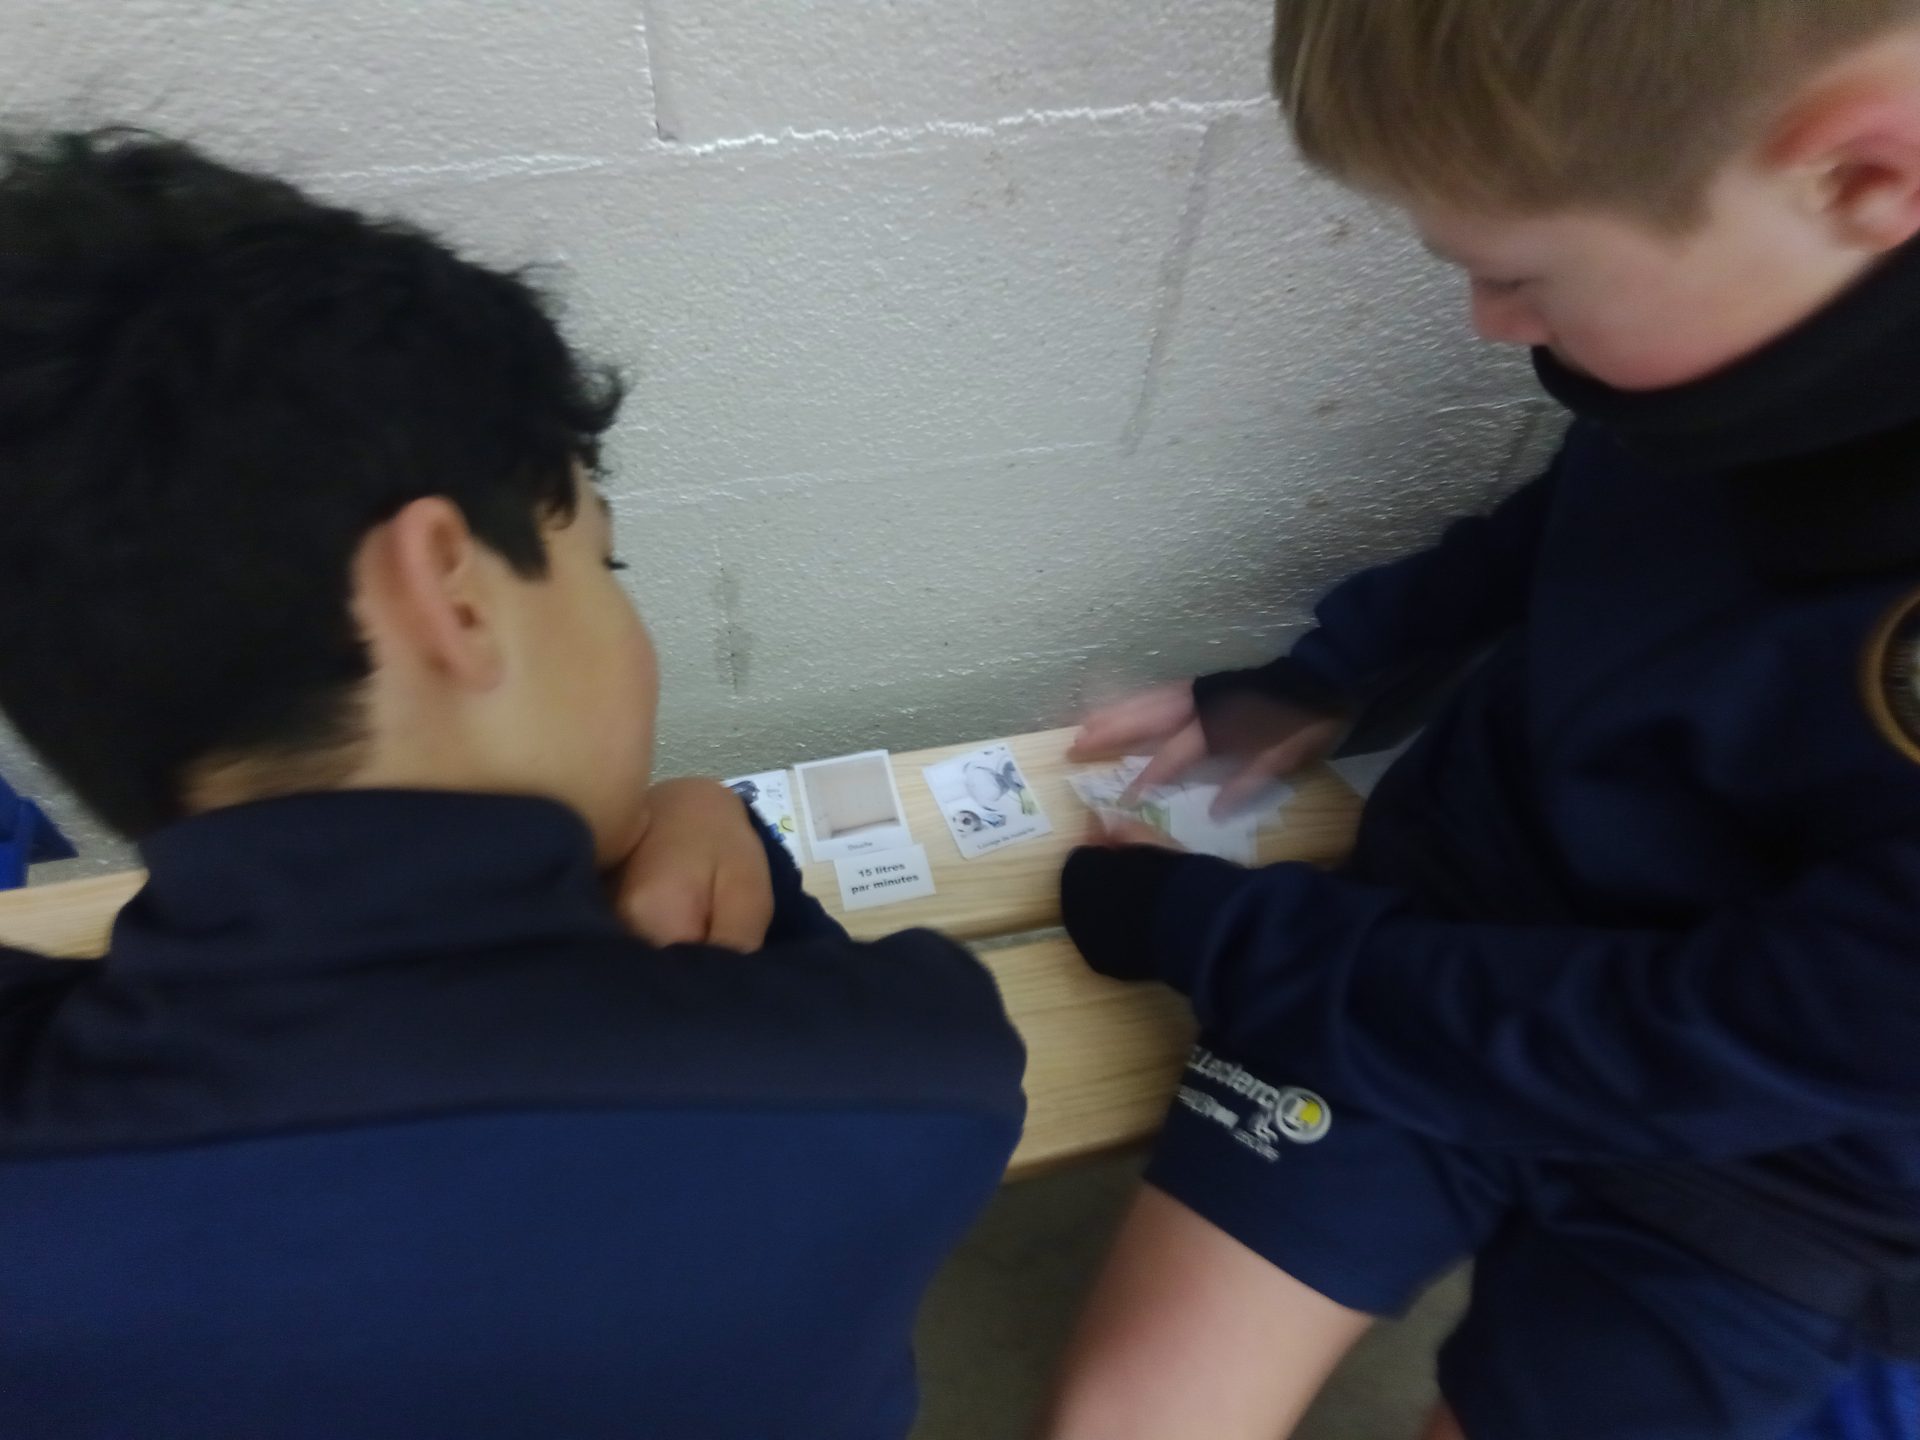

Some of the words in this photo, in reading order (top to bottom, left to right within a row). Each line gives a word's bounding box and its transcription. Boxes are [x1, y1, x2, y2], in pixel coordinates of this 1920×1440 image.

[858, 867, 872, 878] 15
[875, 863, 906, 876] litres
[851, 882, 870, 895] par
[873, 874, 919, 889] minutes
